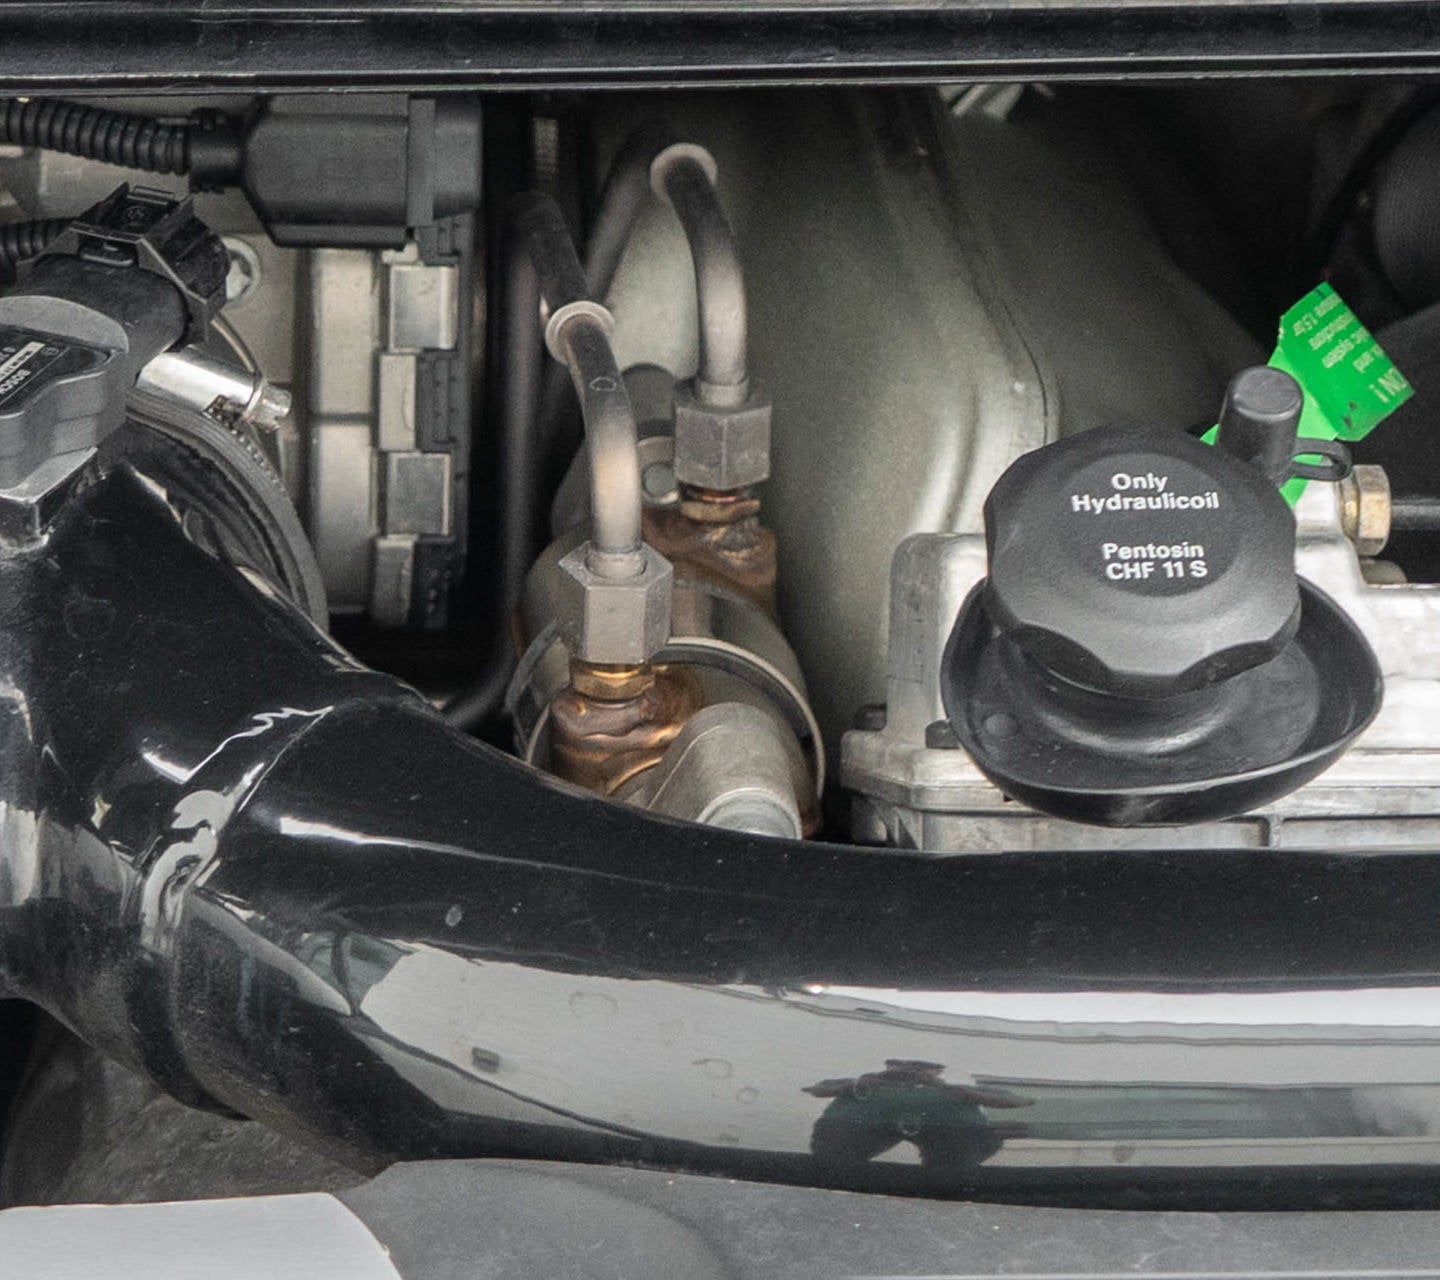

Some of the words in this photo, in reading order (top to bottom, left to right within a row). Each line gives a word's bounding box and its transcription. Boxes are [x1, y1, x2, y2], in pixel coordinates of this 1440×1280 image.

[1111, 473, 1168, 493] Only
[1071, 491, 1220, 512] Hydraulicoil
[1102, 541, 1205, 561] Pentosin
[1106, 561, 1155, 580] CHF
[1163, 561, 1186, 578] 11
[1189, 560, 1208, 578] S
